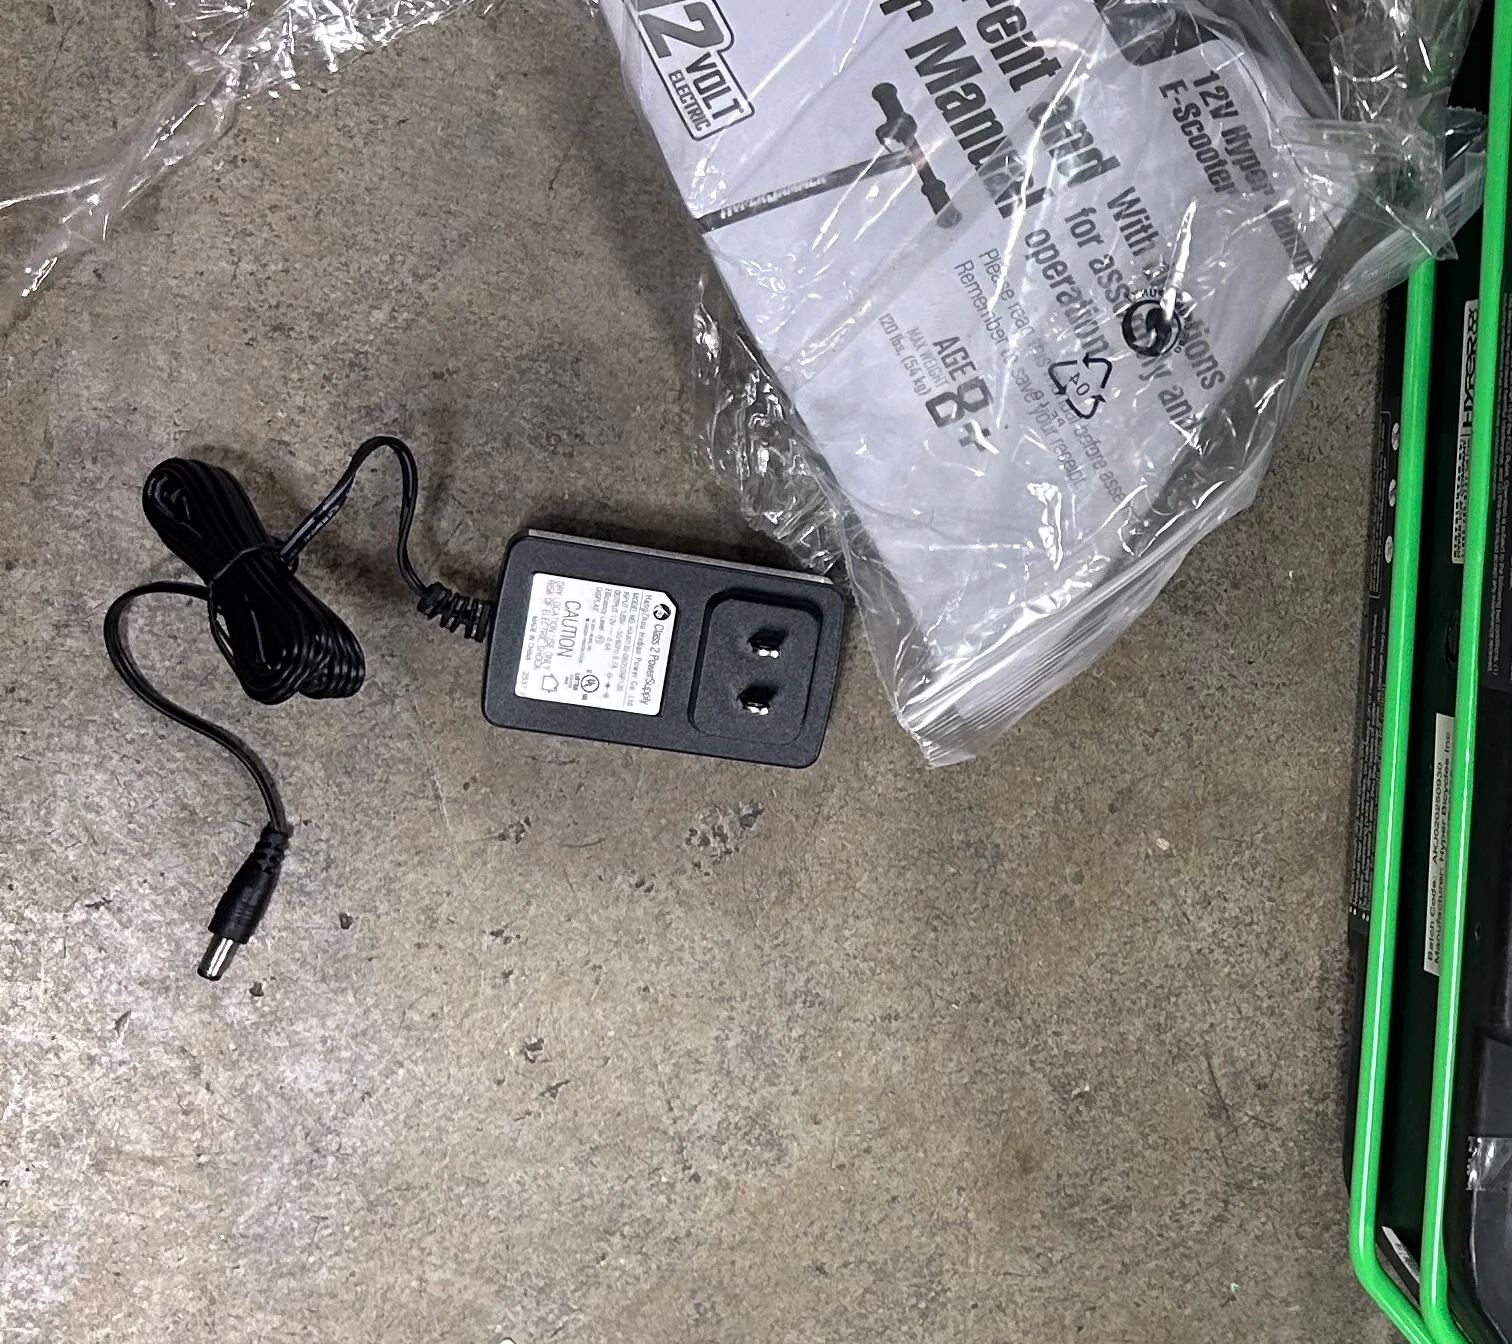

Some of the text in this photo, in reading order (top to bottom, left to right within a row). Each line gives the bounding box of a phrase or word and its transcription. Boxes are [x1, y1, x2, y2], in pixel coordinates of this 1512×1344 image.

[668, 69, 711, 132] ELECTRIC
[686, 52, 745, 120] VOLT
[904, 26, 1047, 219] Manual
[1025, 94, 1121, 188] and
[1158, 79, 1238, 194] E-Scooter
[1192, 70, 1240, 124] 12V
[1217, 124, 1273, 197] Hyper
[1064, 207, 1106, 250] for
[1107, 186, 1160, 250] With
[1024, 228, 1112, 359] operation
[877, 313, 896, 335] 120
[955, 260, 1010, 348] Remember
[1010, 367, 1040, 402] save
[1029, 404, 1060, 440] your
[906, 328, 949, 389] MAX WEIGHT
[933, 337, 973, 376] AGE
[979, 249, 1015, 300] Please
[1075, 422, 1110, 469] before
[537, 608, 550, 641] ELECTRIC
[541, 580, 564, 670] DRY LOCATION USE ONLY
[543, 598, 552, 606] OF
[556, 599, 581, 658] CAUTION
[598, 616, 606, 631] Level
[651, 623, 664, 645] Class
[631, 657, 641, 678] Power
[1440, 758, 1450, 815] Bicycles
[1438, 821, 1447, 861] Hyper
[1426, 921, 1434, 960] Batch
